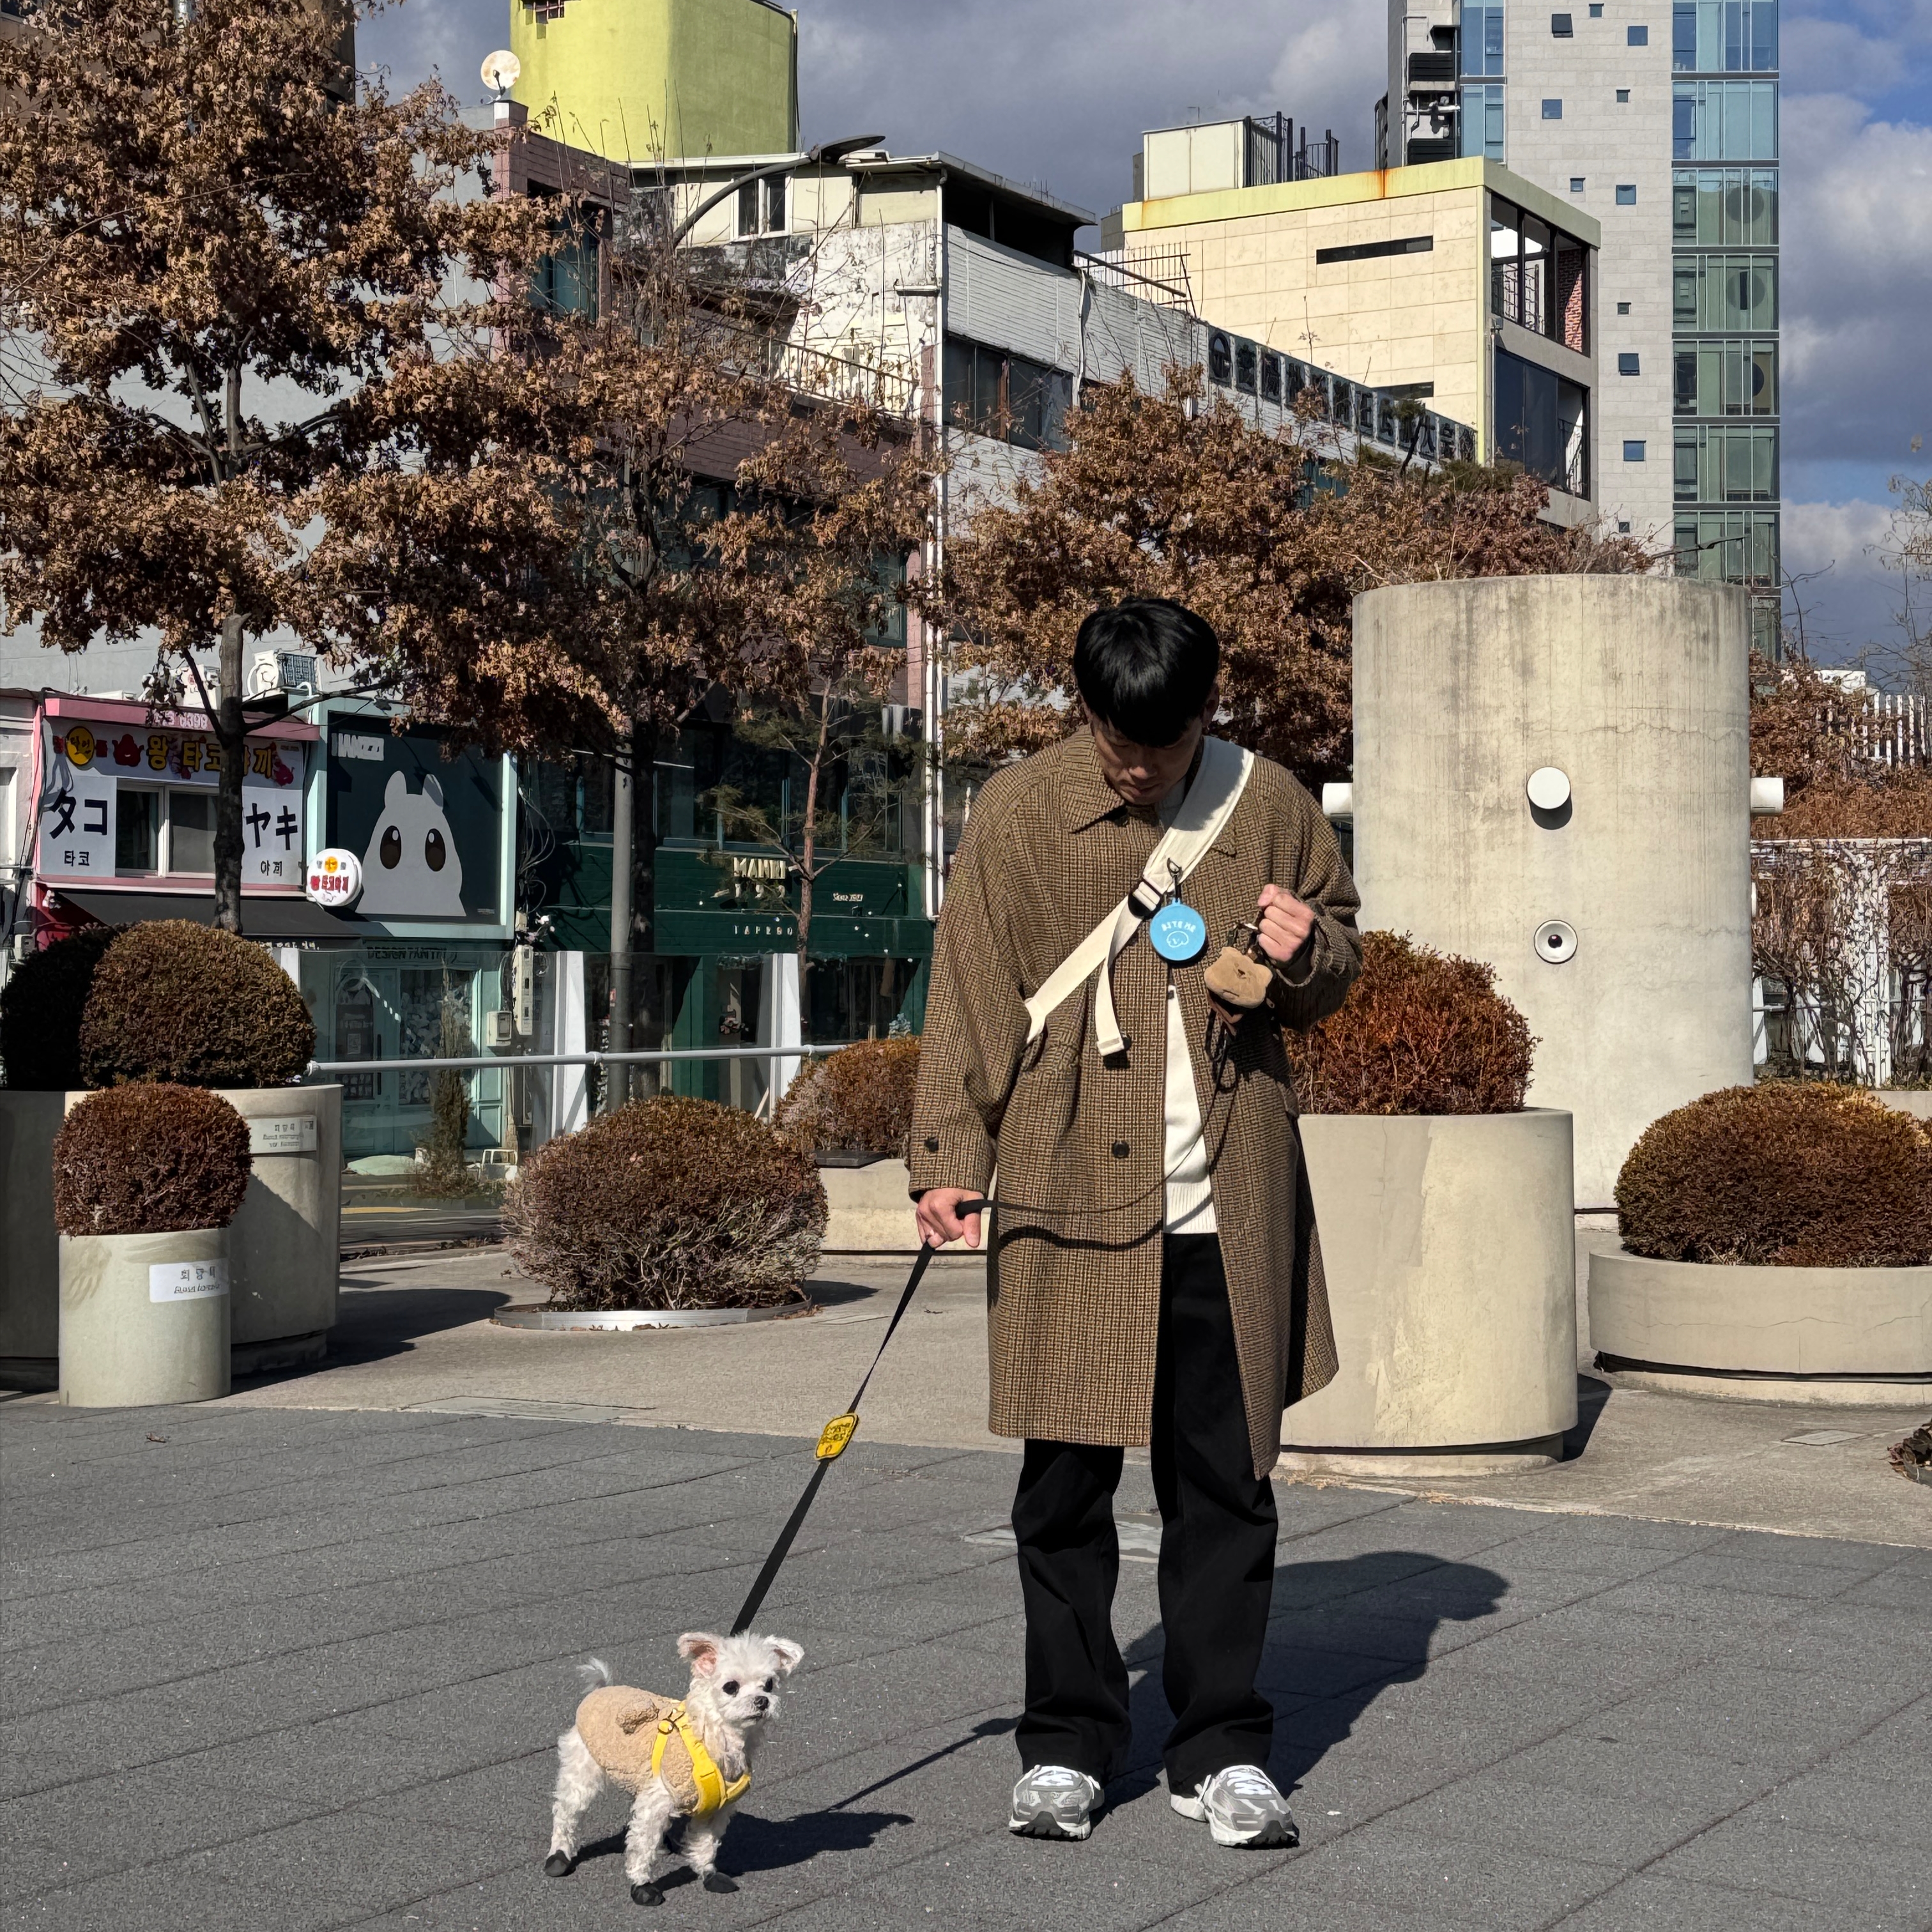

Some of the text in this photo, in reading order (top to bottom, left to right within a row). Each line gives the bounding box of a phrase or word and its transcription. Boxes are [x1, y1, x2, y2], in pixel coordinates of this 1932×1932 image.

[49, 786, 298, 851] タコ ヤキ
[64, 850, 90, 867] 타코
